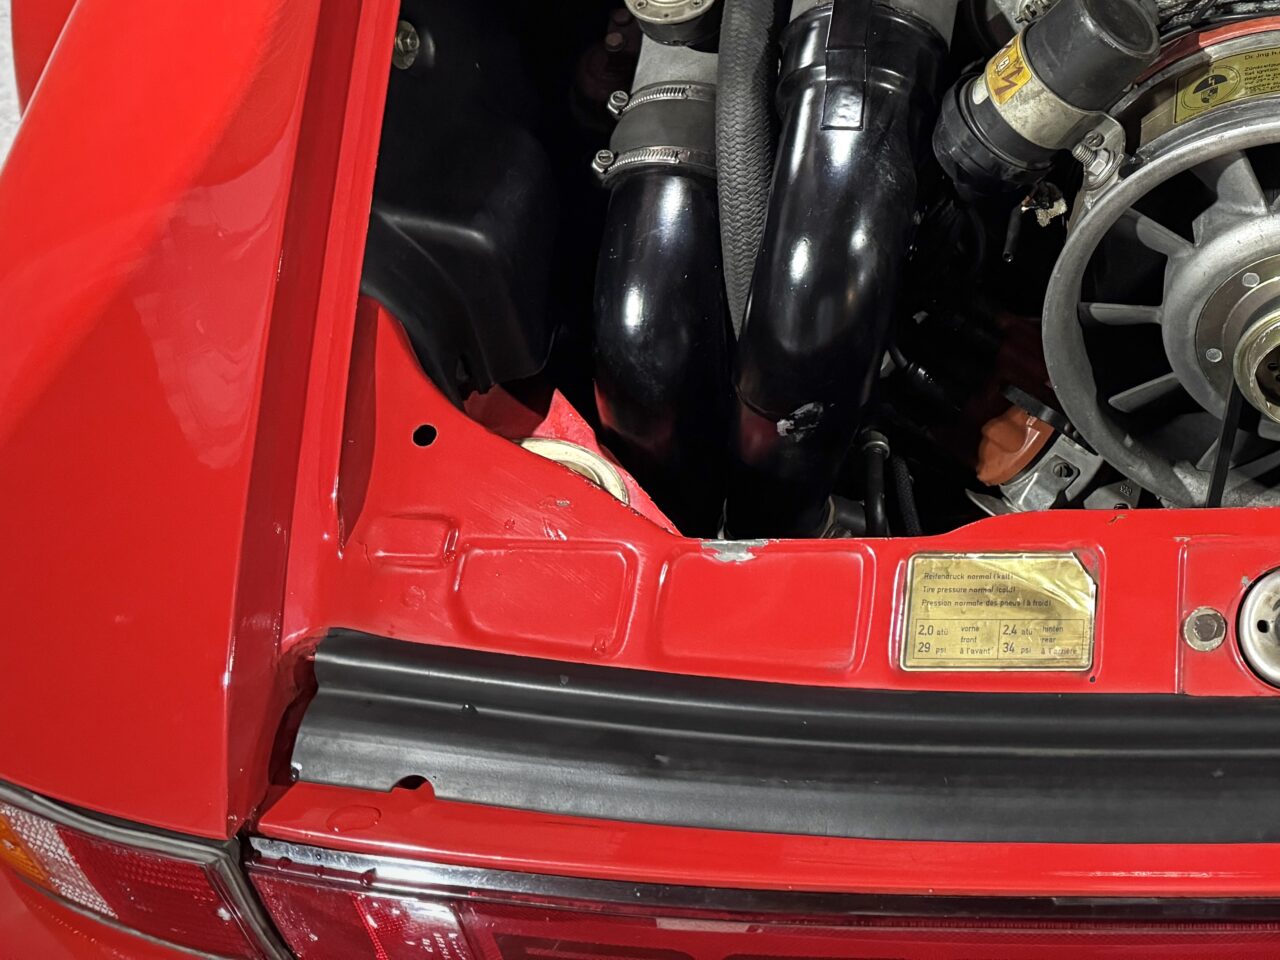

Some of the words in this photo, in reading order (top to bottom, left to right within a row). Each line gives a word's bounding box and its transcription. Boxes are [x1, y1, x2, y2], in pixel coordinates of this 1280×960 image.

[924, 572, 964, 580] Reifendruck
[918, 642, 930, 653] 29
[936, 647, 946, 655] psi
[1003, 642, 1015, 653] 34
